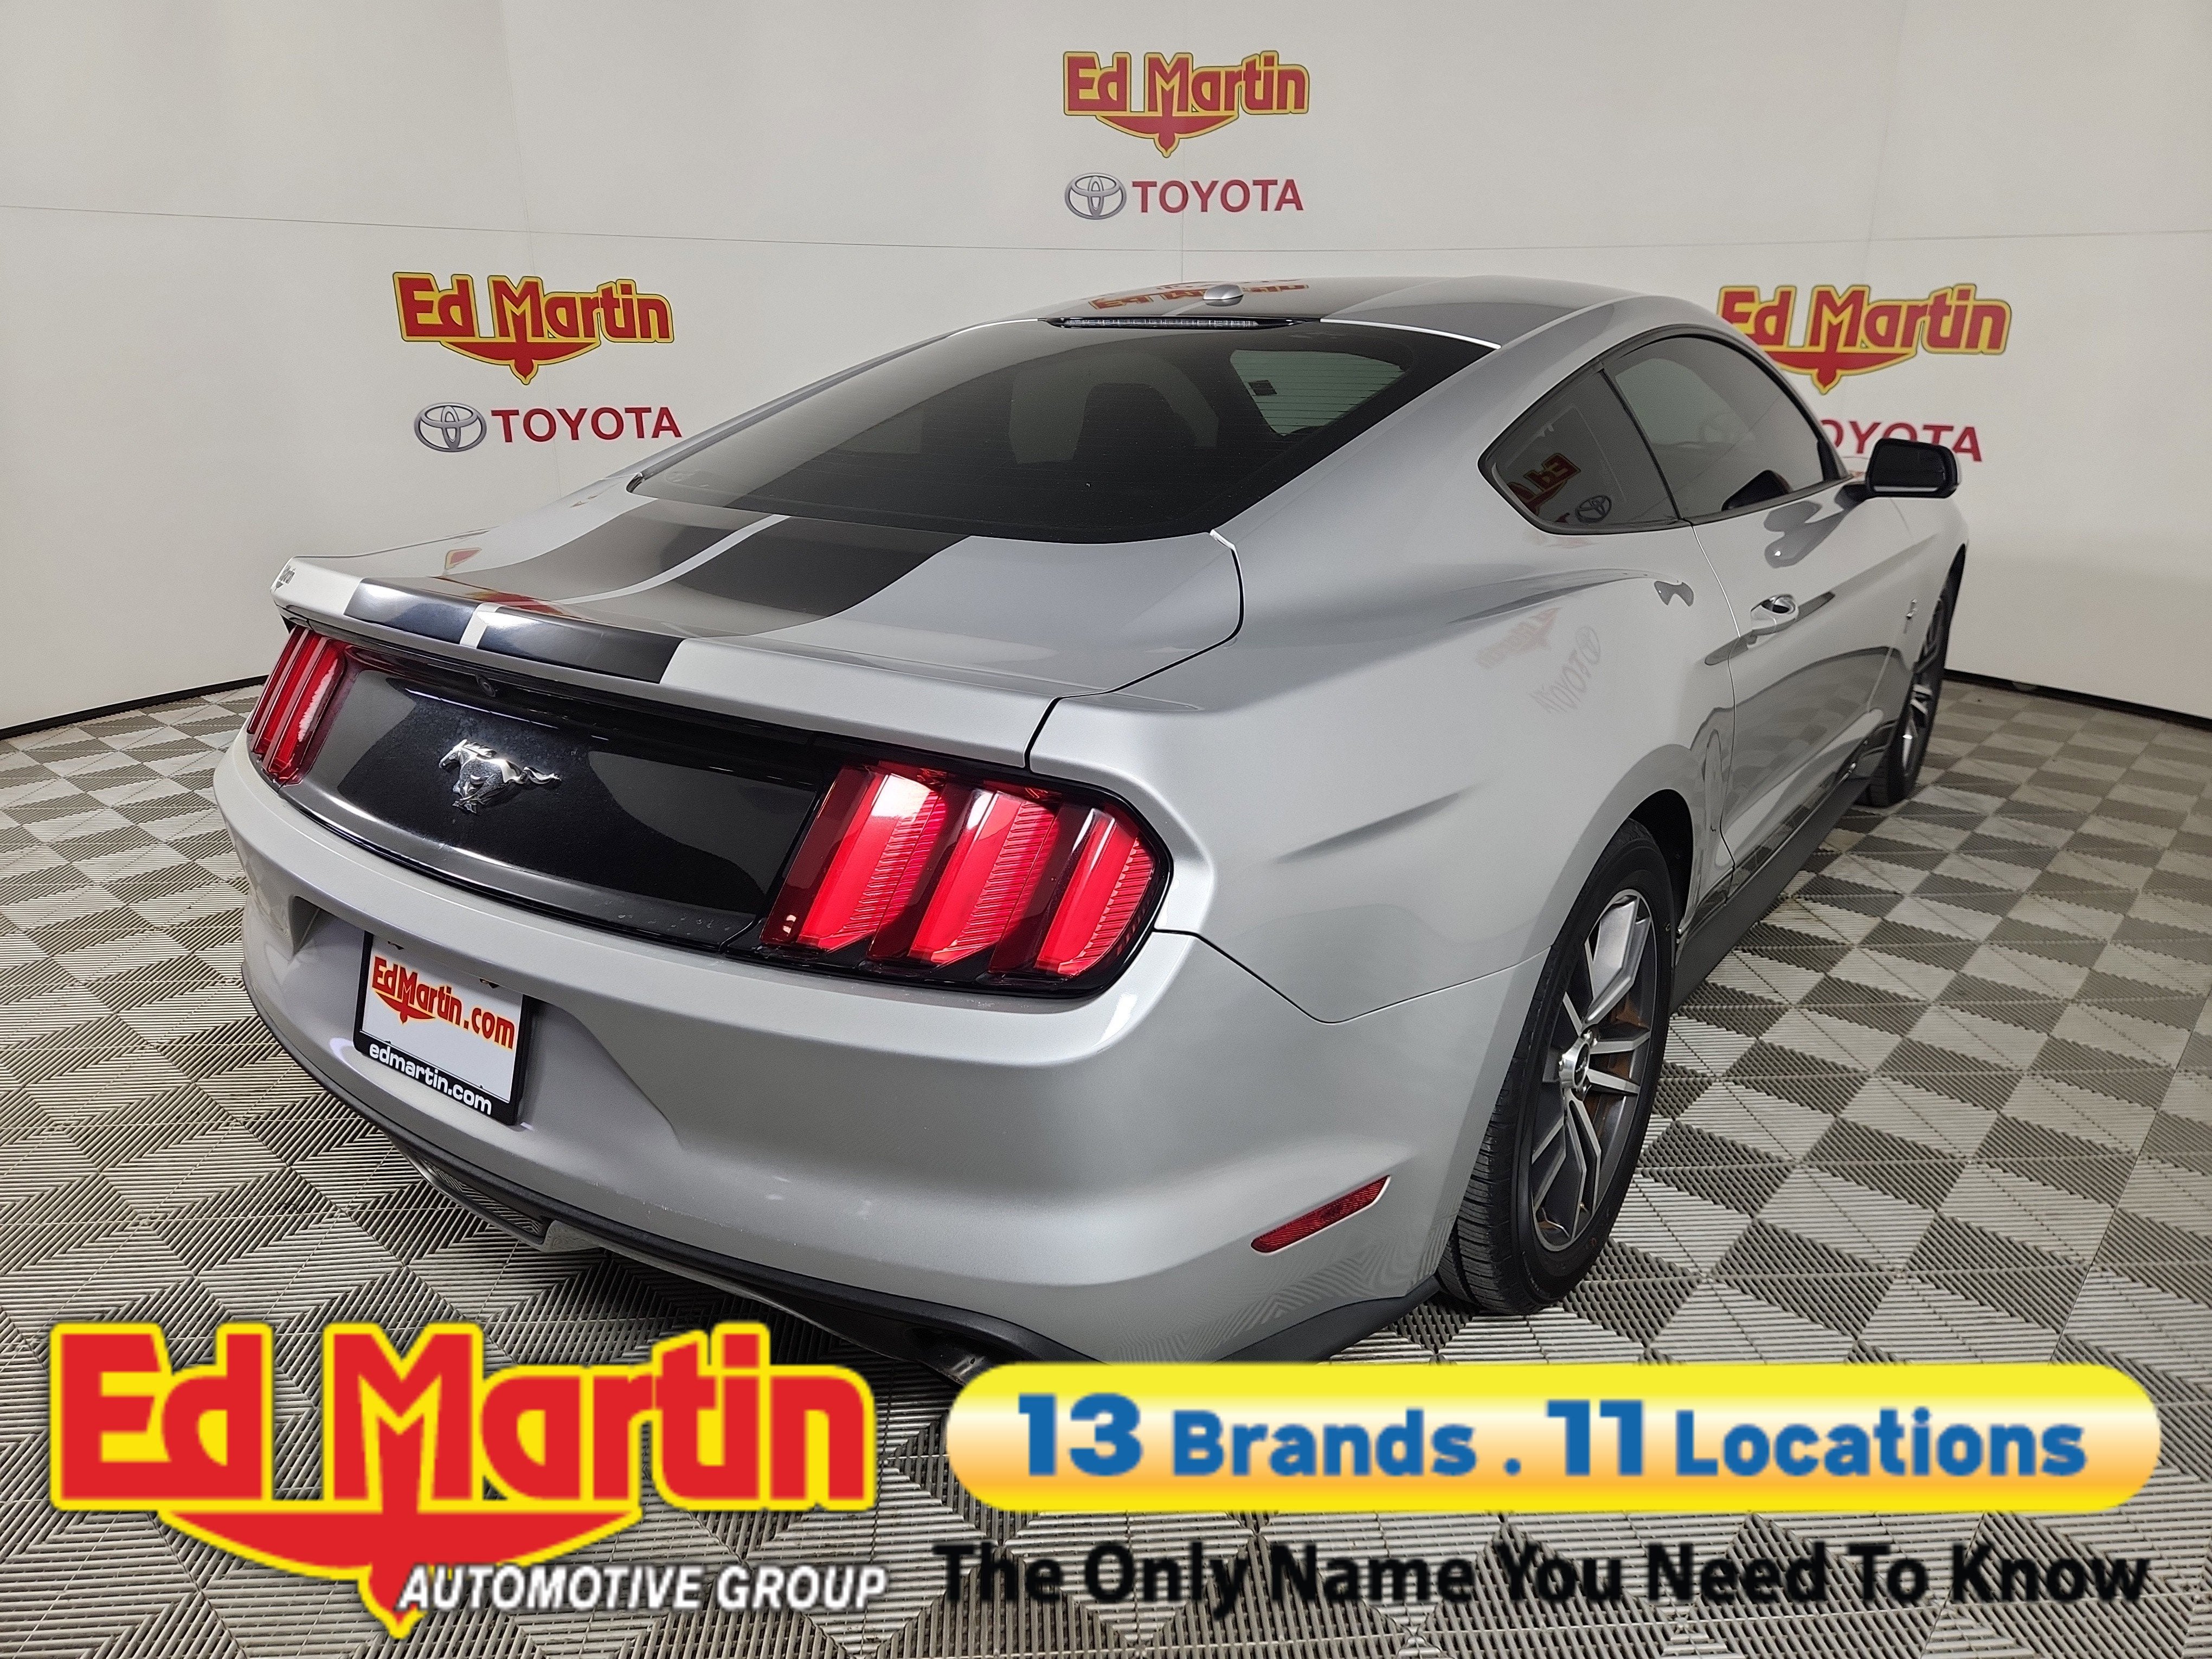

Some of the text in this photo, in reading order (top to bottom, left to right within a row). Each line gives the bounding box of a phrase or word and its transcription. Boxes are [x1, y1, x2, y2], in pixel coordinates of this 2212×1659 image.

[1066, 53, 1307, 112] Ed Martin
[1131, 179, 1304, 213] TOYOTA
[396, 274, 671, 339] Ed Martin
[1721, 288, 2007, 350] Ed Martin
[491, 407, 682, 443] TOYOTA
[1821, 419, 1982, 461] OYOTA
[371, 956, 515, 1050] EdMartin.com
[369, 1043, 492, 1115] edmartin.com
